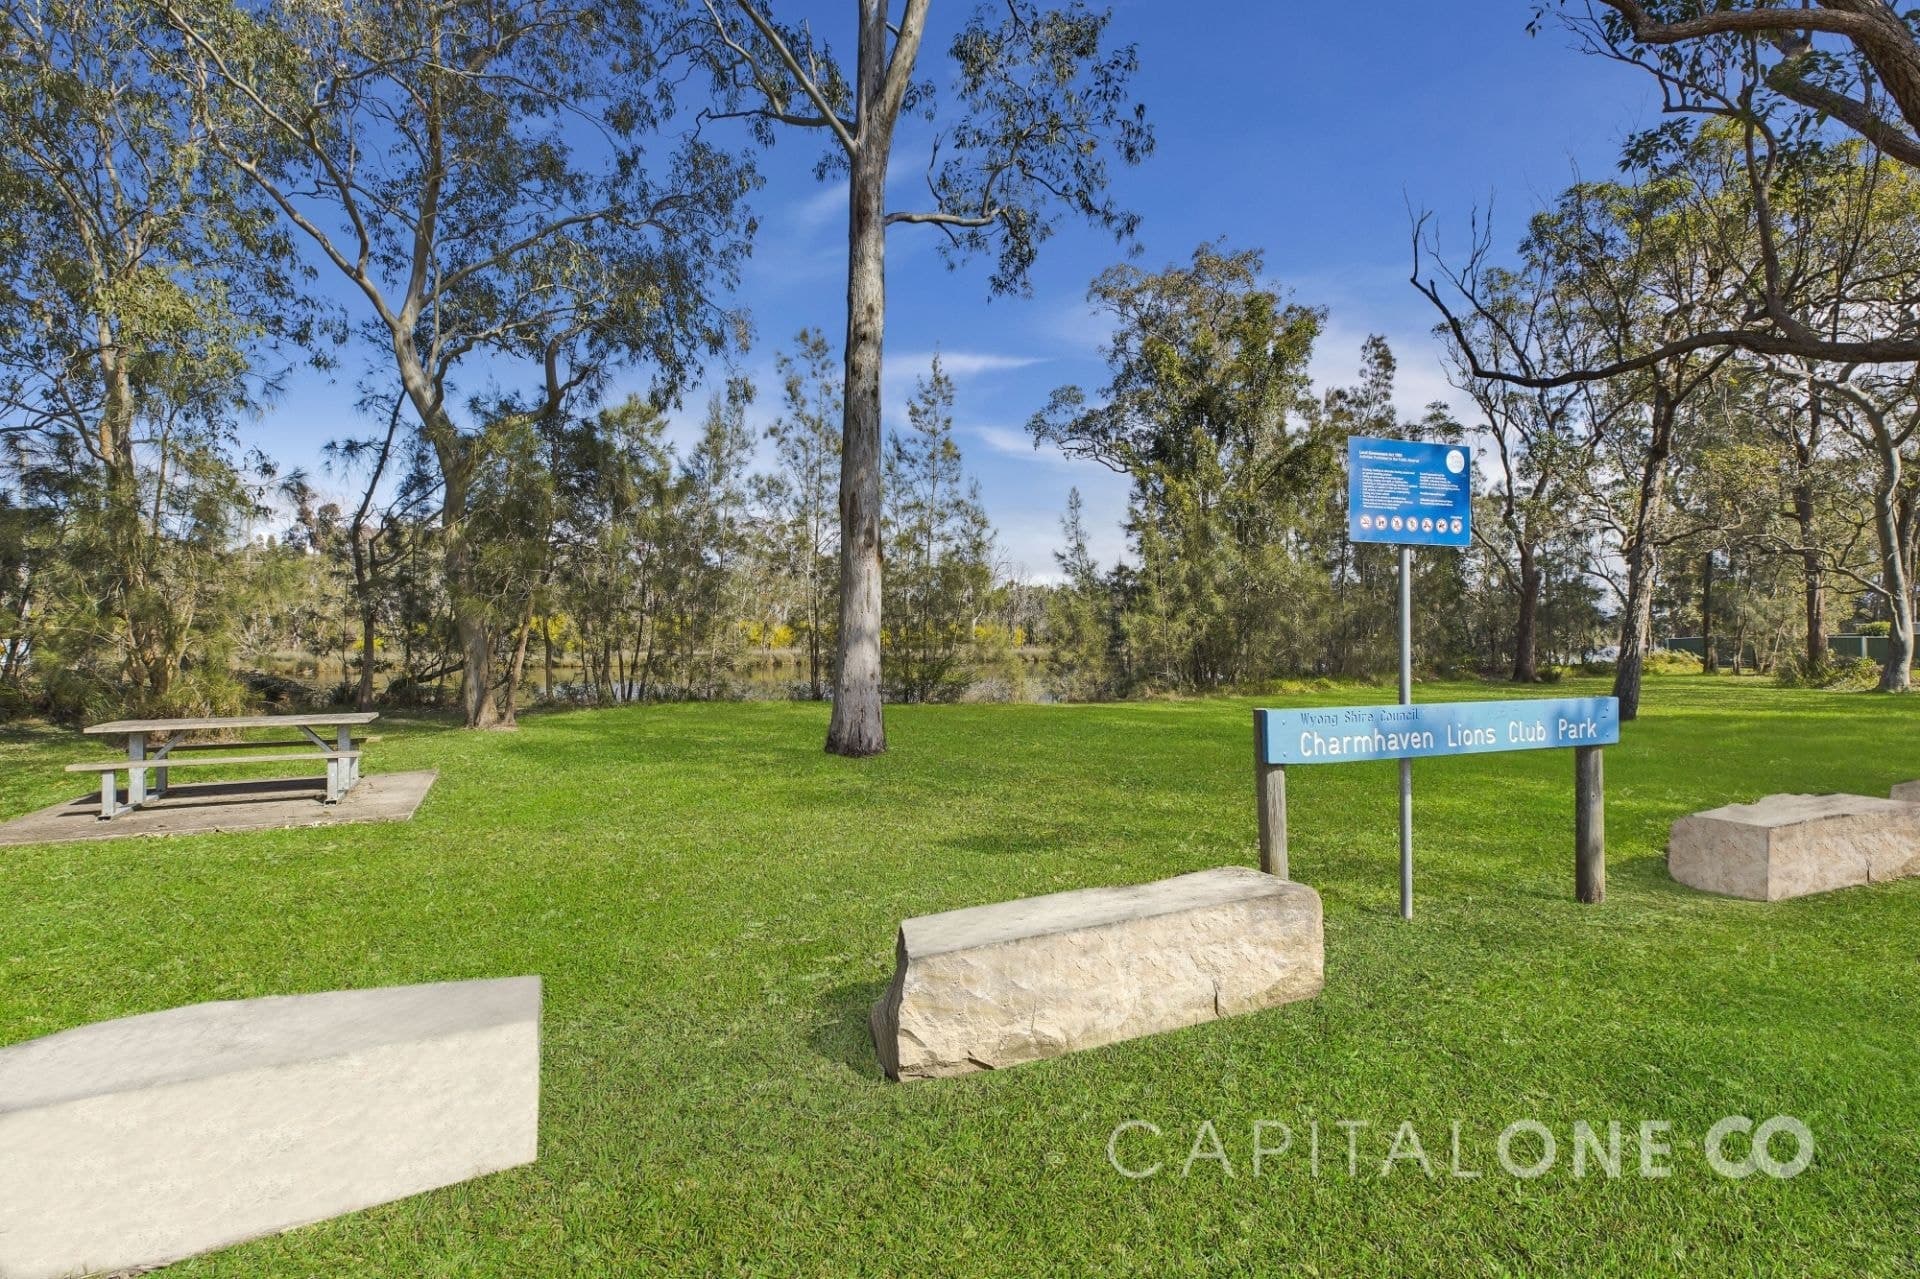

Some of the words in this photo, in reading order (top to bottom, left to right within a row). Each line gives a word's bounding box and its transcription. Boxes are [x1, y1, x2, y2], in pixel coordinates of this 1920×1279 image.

[1300, 711, 1338, 726] Wyong
[1344, 710, 1375, 723] Shire
[1380, 708, 1419, 721] Council
[1300, 728, 1434, 756] Charmhaven
[1447, 724, 1496, 747] Lions
[1508, 720, 1546, 743] Club
[1558, 718, 1598, 740] Park
